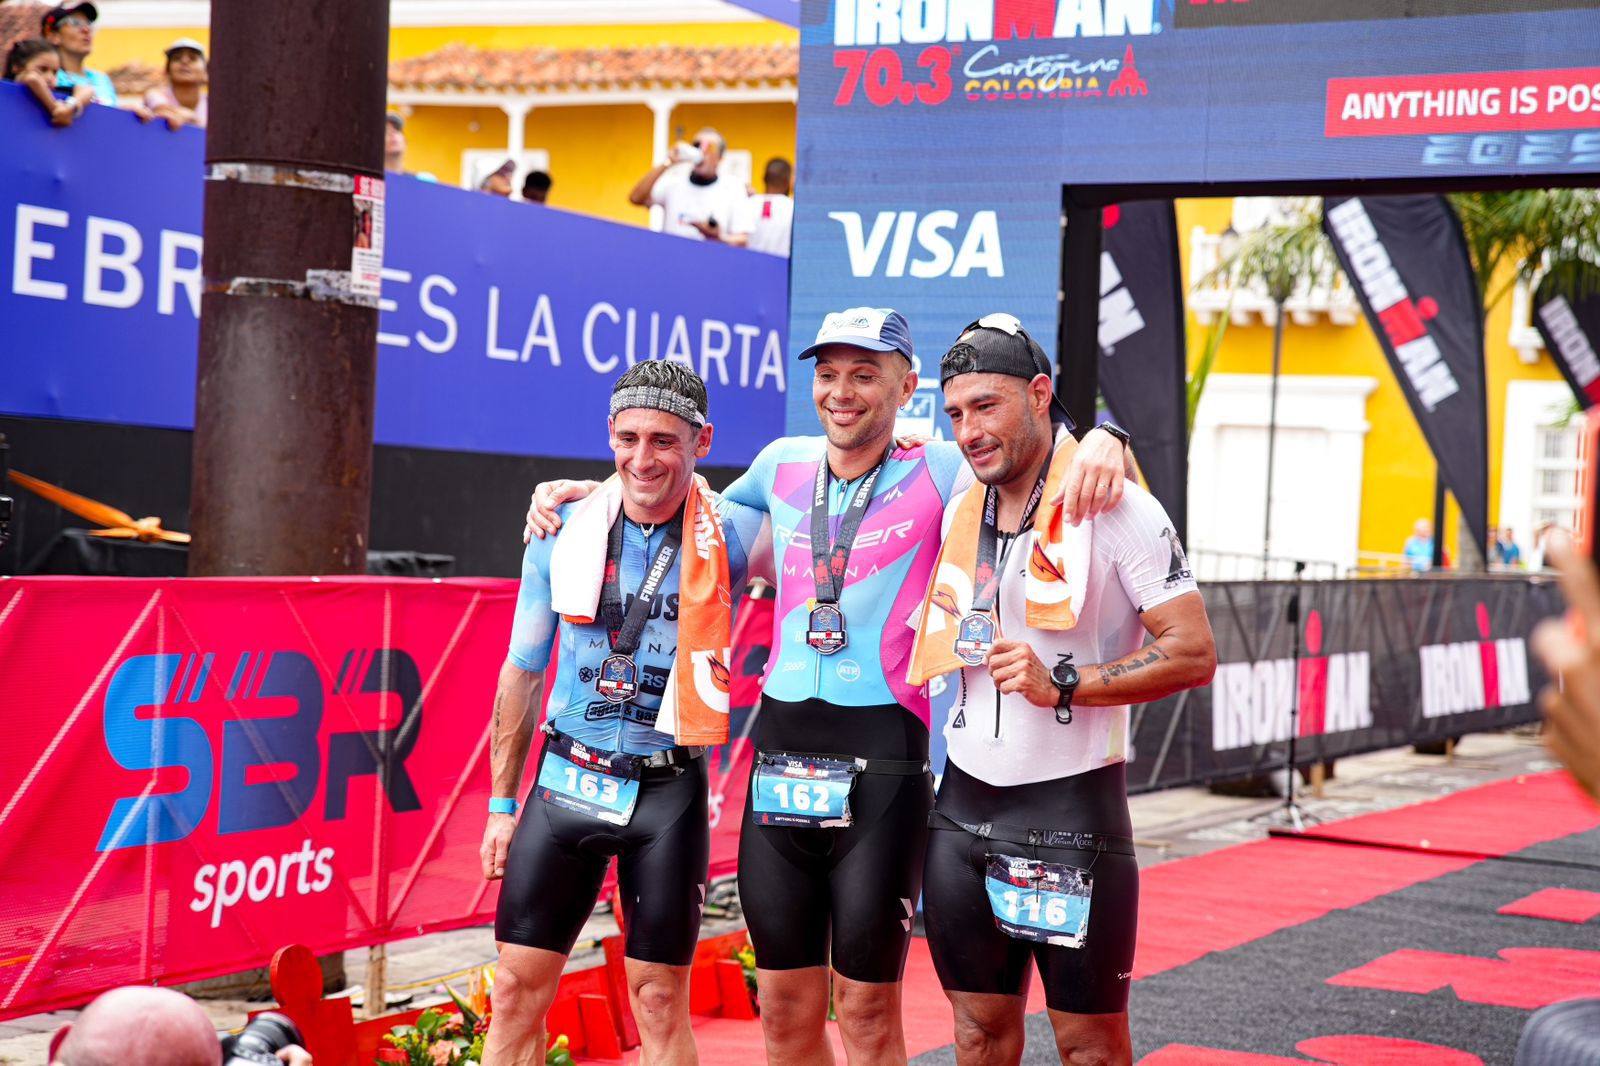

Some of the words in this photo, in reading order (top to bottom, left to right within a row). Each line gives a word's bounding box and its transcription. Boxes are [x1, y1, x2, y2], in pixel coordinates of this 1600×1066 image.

[834, 0, 1153, 45] IRONMAN
[833, 46, 953, 106] 70.3
[1342, 88, 1502, 120] ANYTHING
[1509, 86, 1538, 114] IS
[1422, 133, 1600, 165] 2025
[828, 210, 1005, 279] VISA
[13, 203, 204, 319] EBR
[486, 286, 561, 367] LA
[582, 302, 787, 393] CUARTA
[1328, 197, 1460, 409] IRONMAN
[640, 545, 674, 602] FINISHER
[1212, 651, 1372, 751] IRONMAN
[1419, 637, 1530, 719] IRONMAN
[95, 647, 423, 852] SBR
[572, 740, 587, 752] VISA
[787, 760, 803, 768] VISA
[564, 767, 619, 804] 163
[773, 782, 830, 813] 162
[189, 838, 335, 928] sports
[1010, 860, 1028, 869] VISA
[1003, 891, 1067, 927] 116
